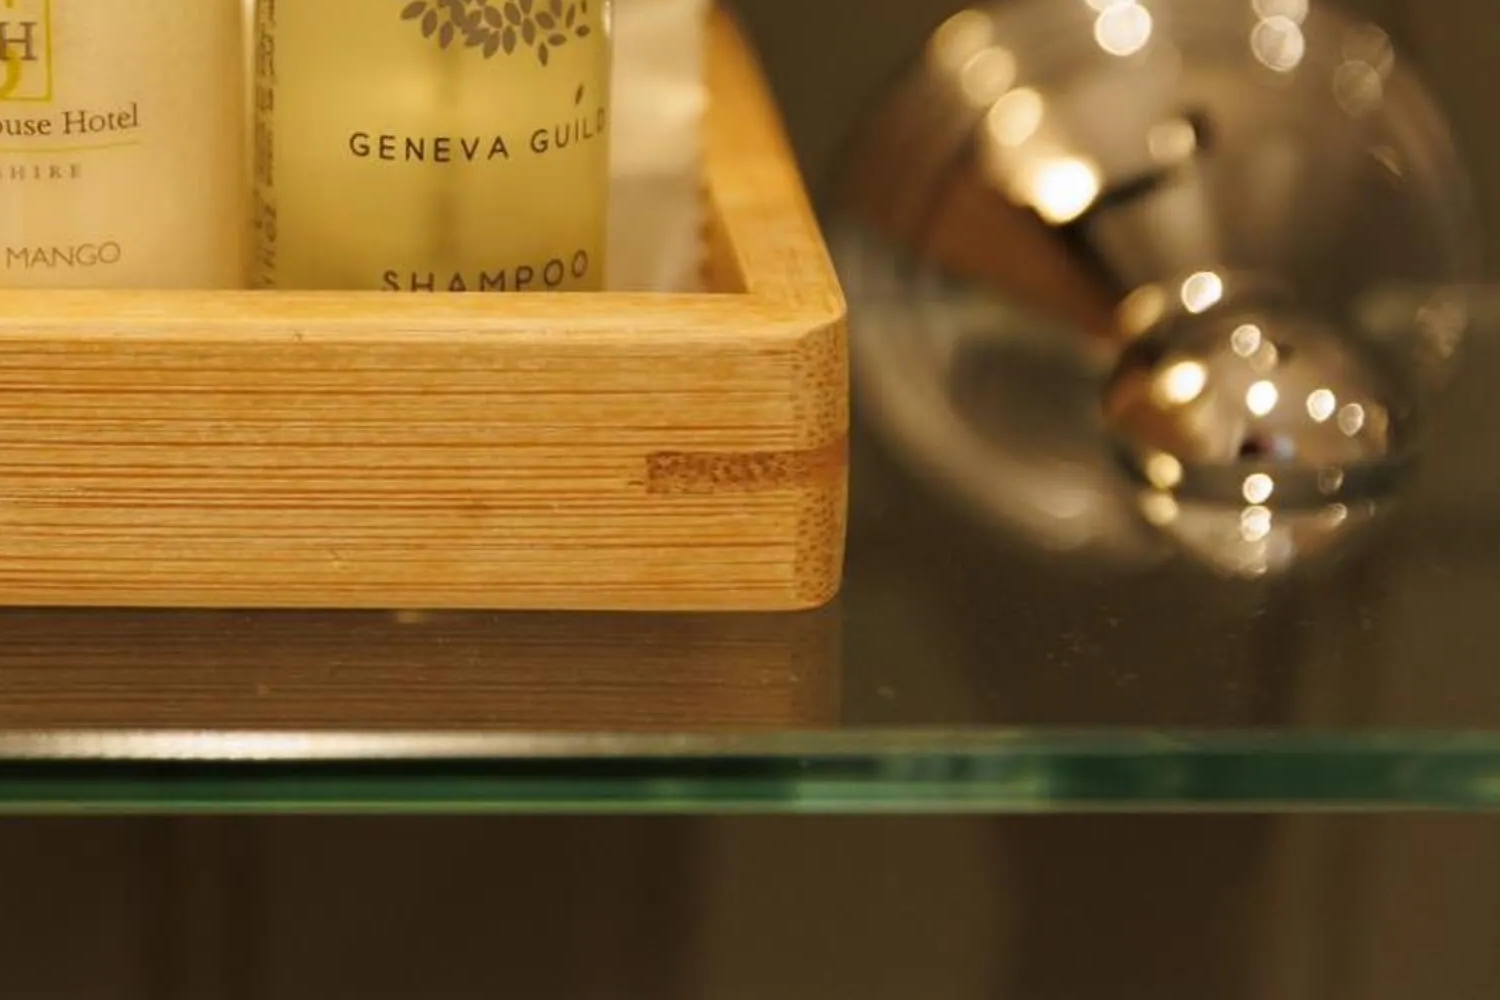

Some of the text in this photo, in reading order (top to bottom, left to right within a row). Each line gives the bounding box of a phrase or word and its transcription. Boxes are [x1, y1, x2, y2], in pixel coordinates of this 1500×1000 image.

[61, 101, 140, 135] Hotel
[348, 106, 606, 163] GENEVA GUILD
[5, 240, 122, 270] MANGO
[380, 248, 589, 292] SHAMPOO
